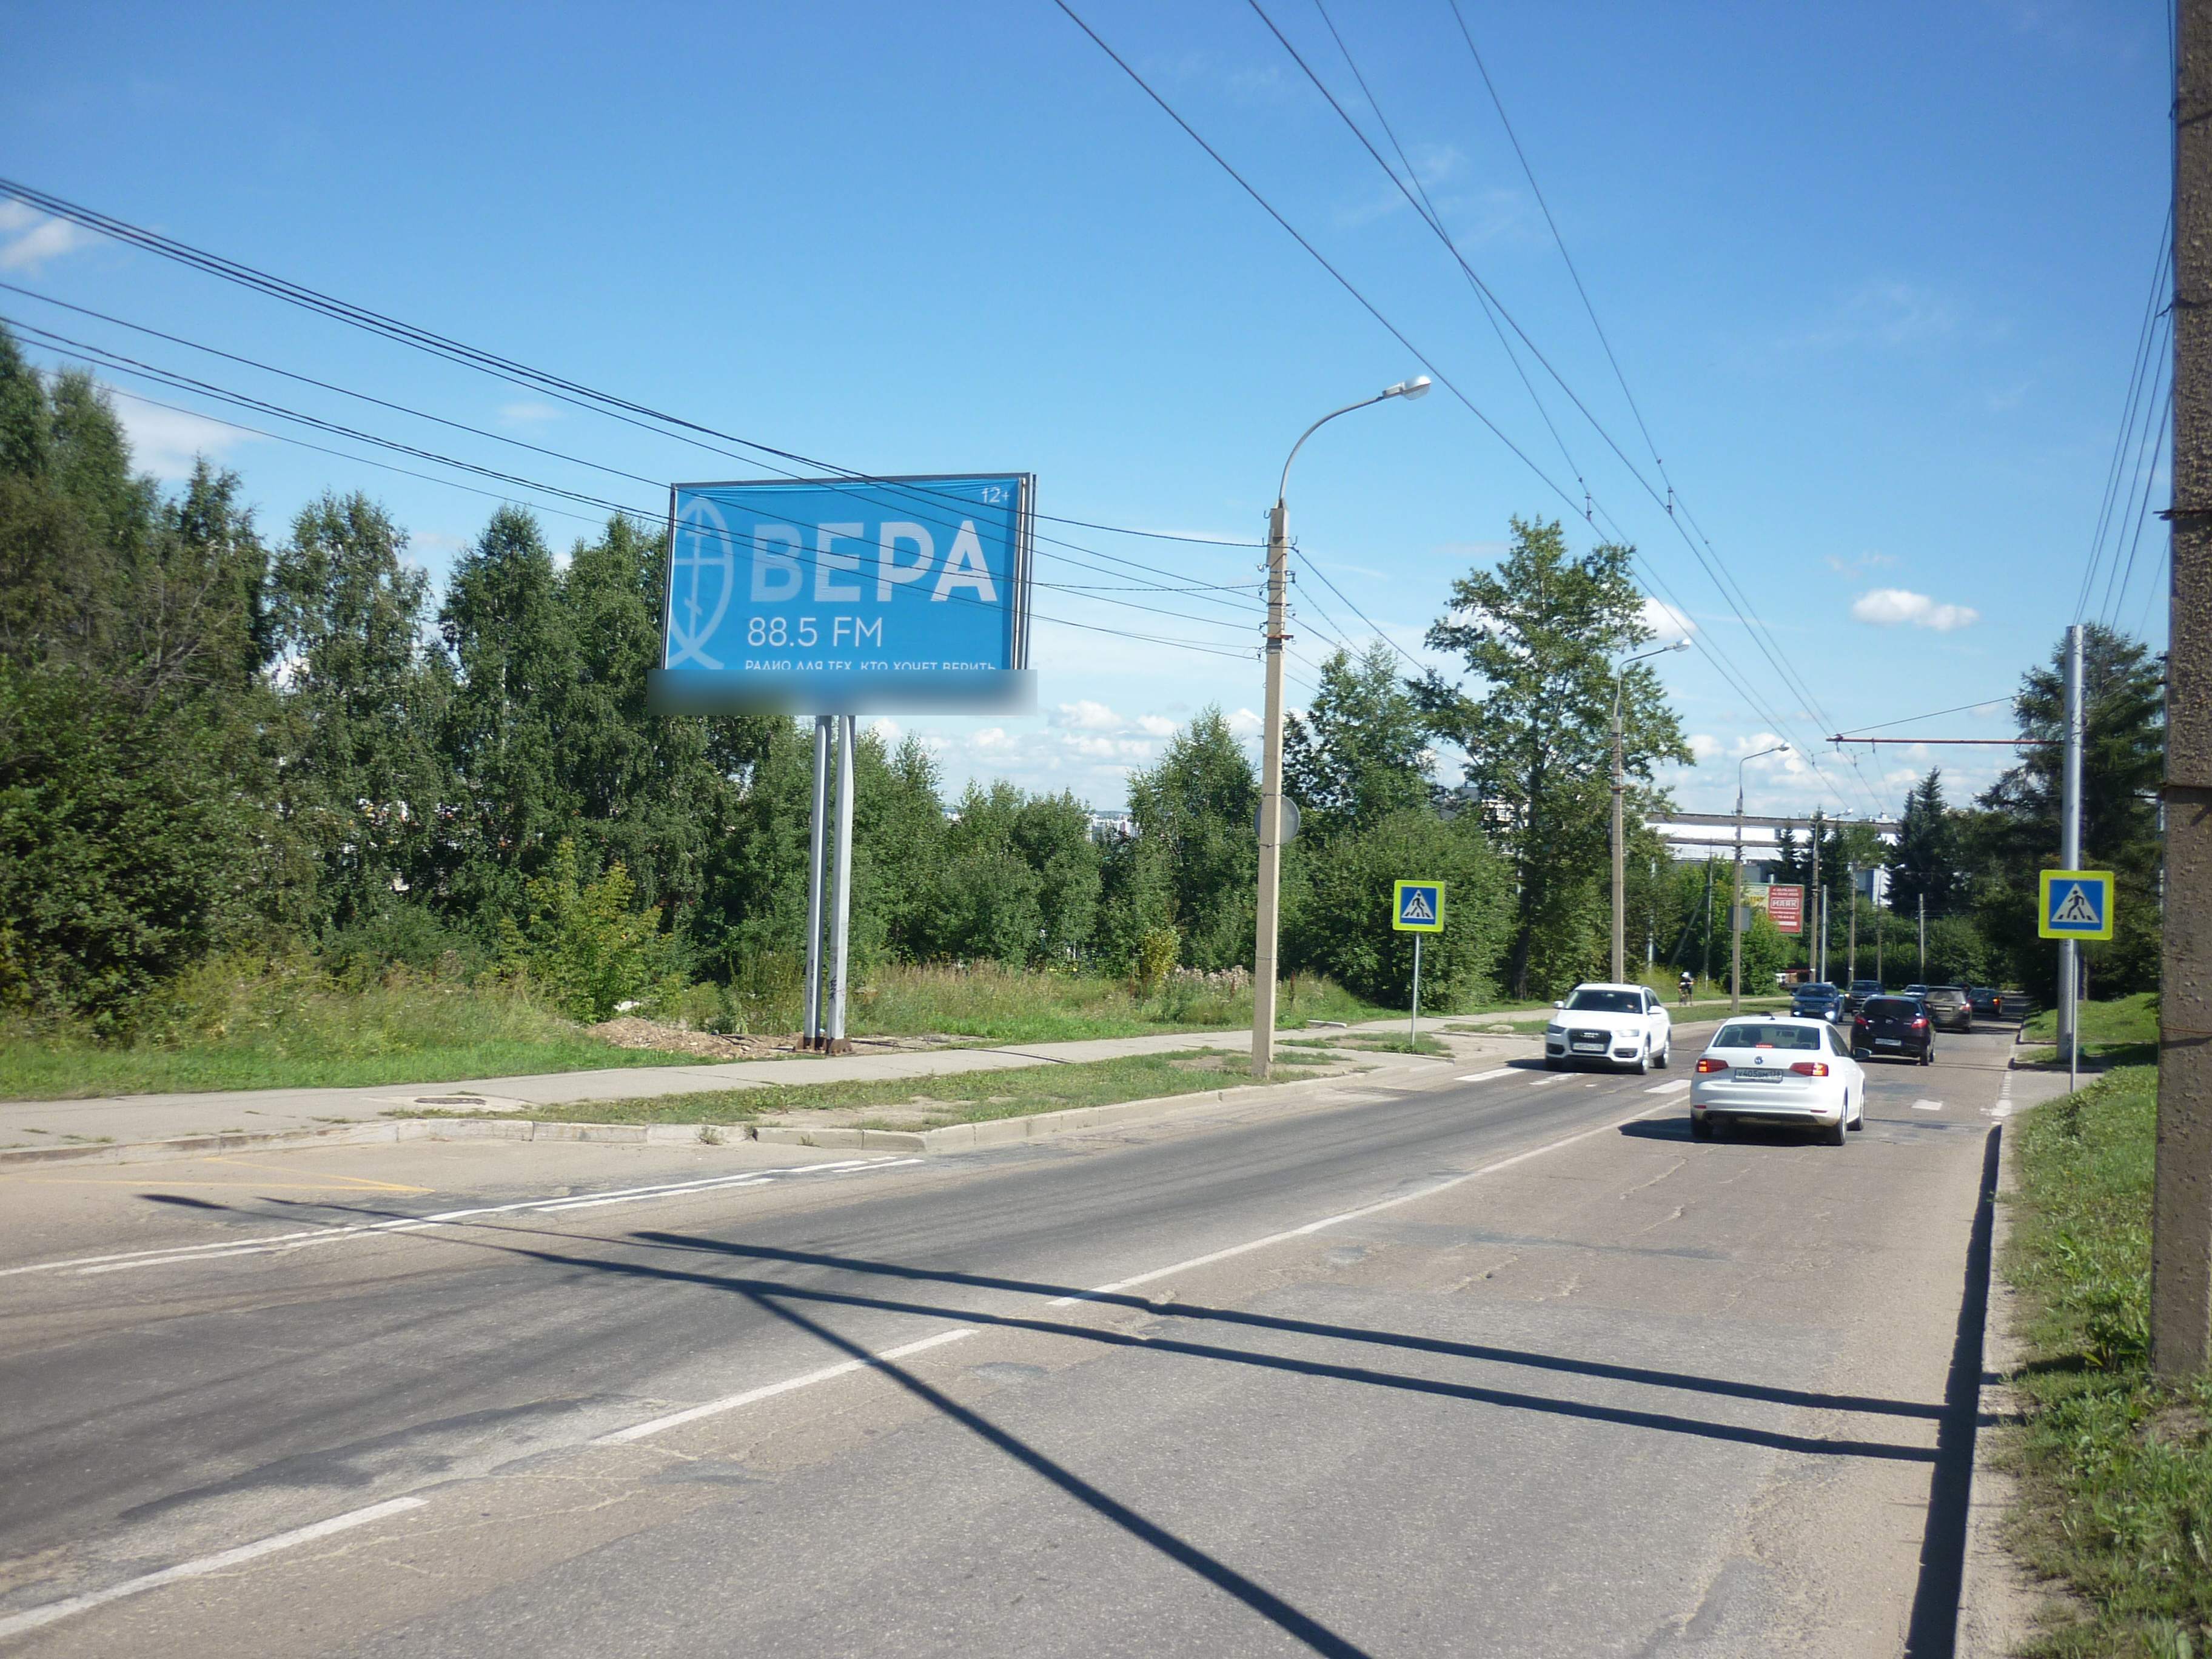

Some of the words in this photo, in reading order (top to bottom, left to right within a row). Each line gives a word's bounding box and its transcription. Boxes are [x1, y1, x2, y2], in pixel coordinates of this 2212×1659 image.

[981, 486, 1010, 504] 12+
[750, 520, 997, 602] ВЕРА
[747, 617, 818, 647] 88.5
[833, 617, 882, 647] FM
